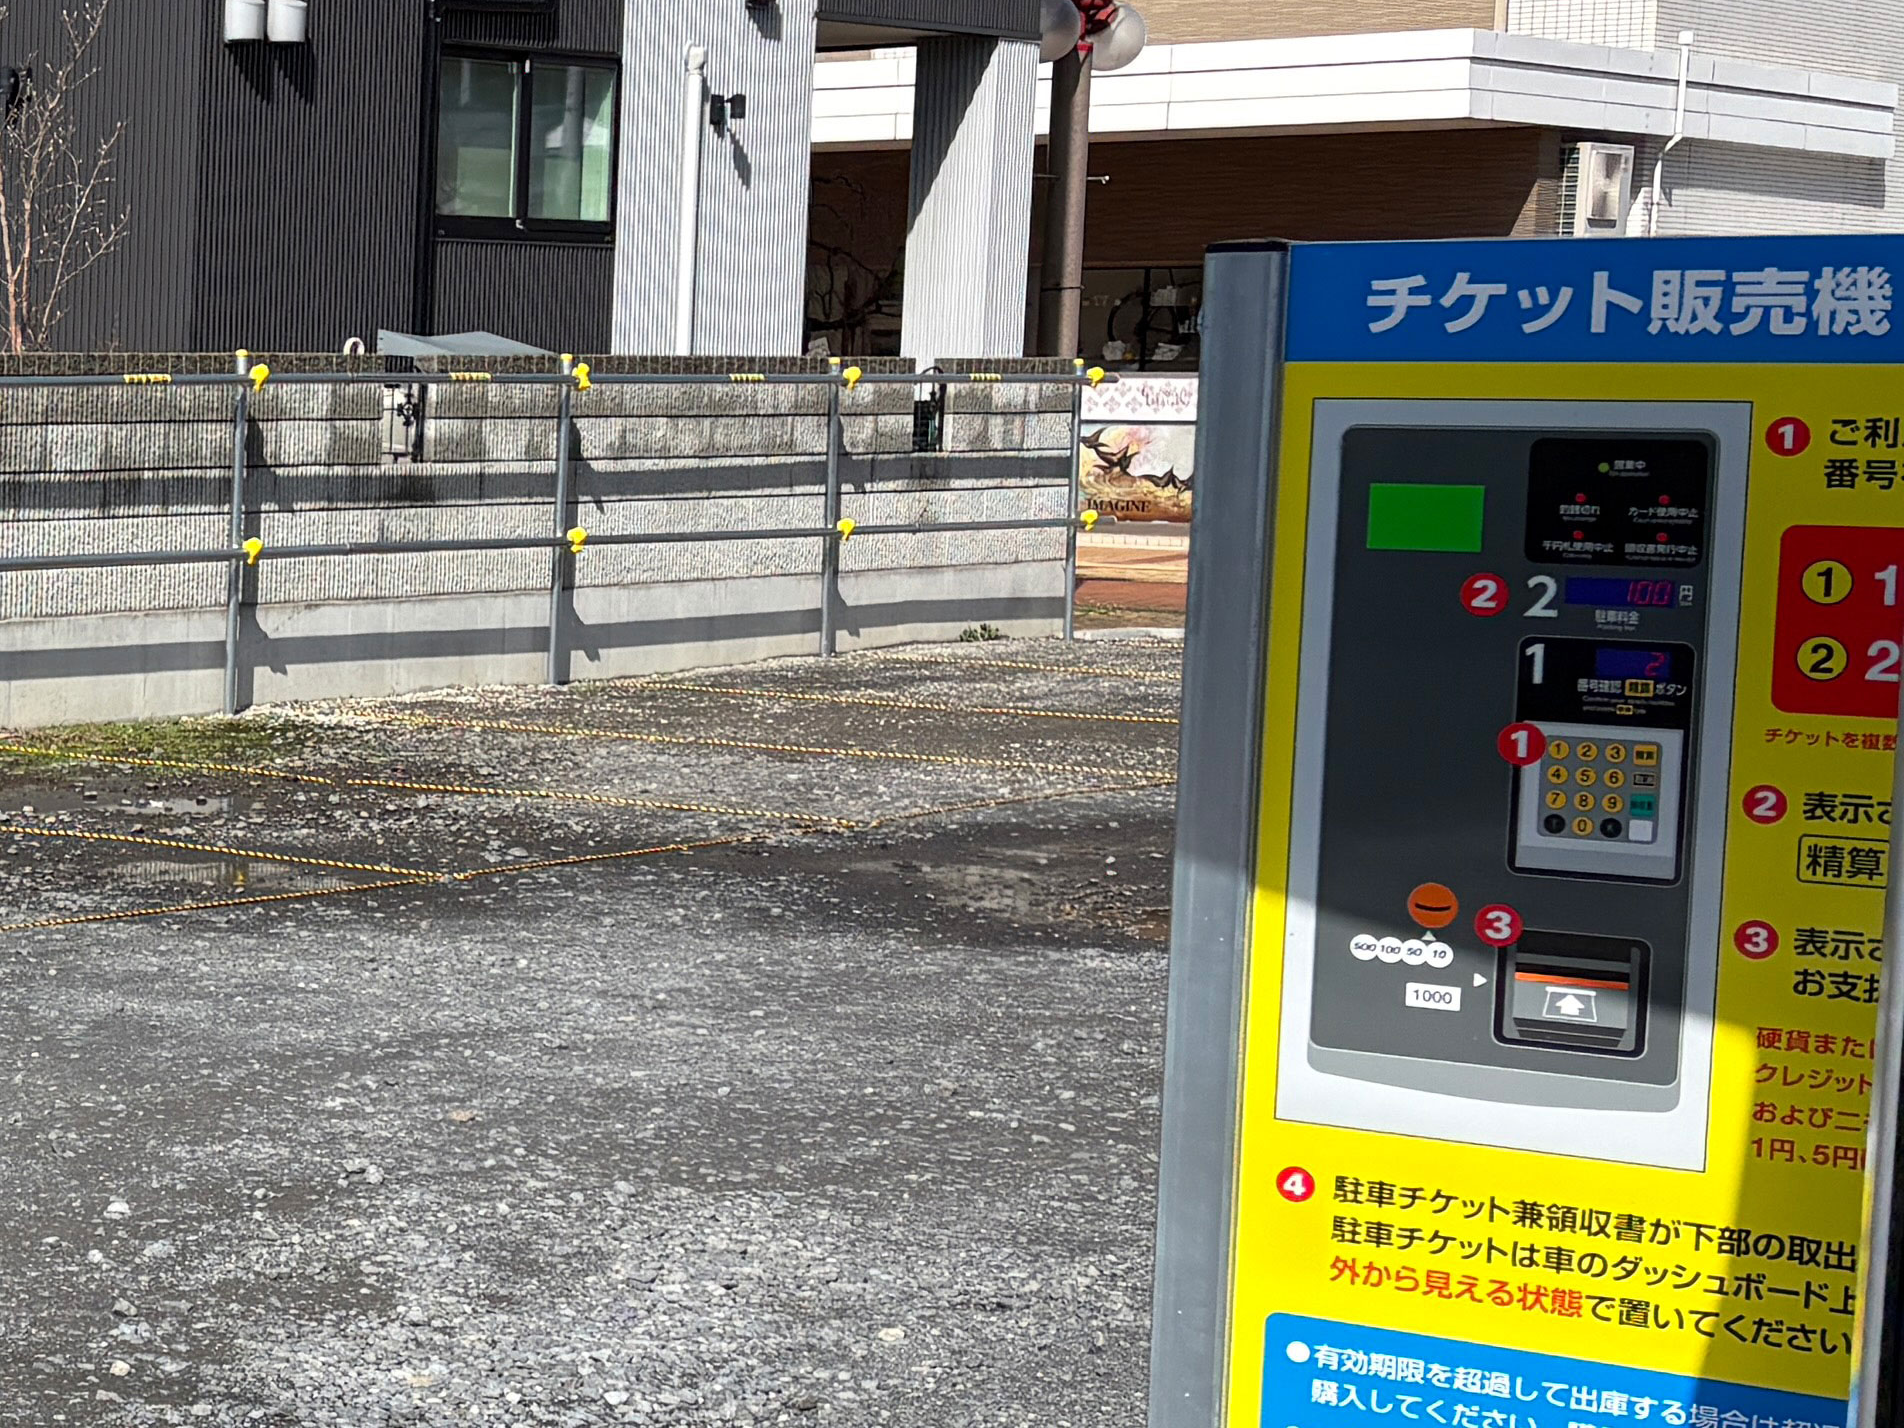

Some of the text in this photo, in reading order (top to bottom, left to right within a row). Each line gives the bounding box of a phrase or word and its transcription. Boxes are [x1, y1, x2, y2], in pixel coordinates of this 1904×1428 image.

[1366, 266, 1893, 336] チケット販売機
[1778, 424, 1795, 449] 1
[1829, 417, 1904, 449] ご利
[1823, 457, 1904, 490] 番号
[1087, 498, 1152, 513] IMAGINE
[1470, 579, 1498, 608] 2
[1523, 575, 1559, 618] 2
[1626, 580, 1672, 605] 100
[1816, 564, 1897, 607] 1 1
[1525, 643, 1545, 685] 1
[1644, 651, 1667, 677] 2
[1809, 639, 1900, 682] 2 2
[1510, 730, 1529, 759] 1
[1752, 790, 1777, 817] 2
[1805, 843, 1886, 881] 精算
[1485, 910, 1512, 940] 3
[1744, 926, 1769, 953] 3
[1353, 941, 1447, 960] 500 100 50 10
[1413, 988, 1453, 1005] 1000
[1756, 1026, 1876, 1060] 硬貨また
[1755, 1062, 1873, 1096] クレジット
[1752, 1101, 1870, 1132] および二
[1751, 1137, 1866, 1172] 1円、5円
[1283, 1173, 1307, 1197] 4
[1332, 1175, 1856, 1273] 駐車チケット兼領収書が下部の取出
[1330, 1215, 1856, 1316] 駐車チケットは車のダッシュボード上
[1329, 1255, 1852, 1356] 外から見える状態で置いてください
